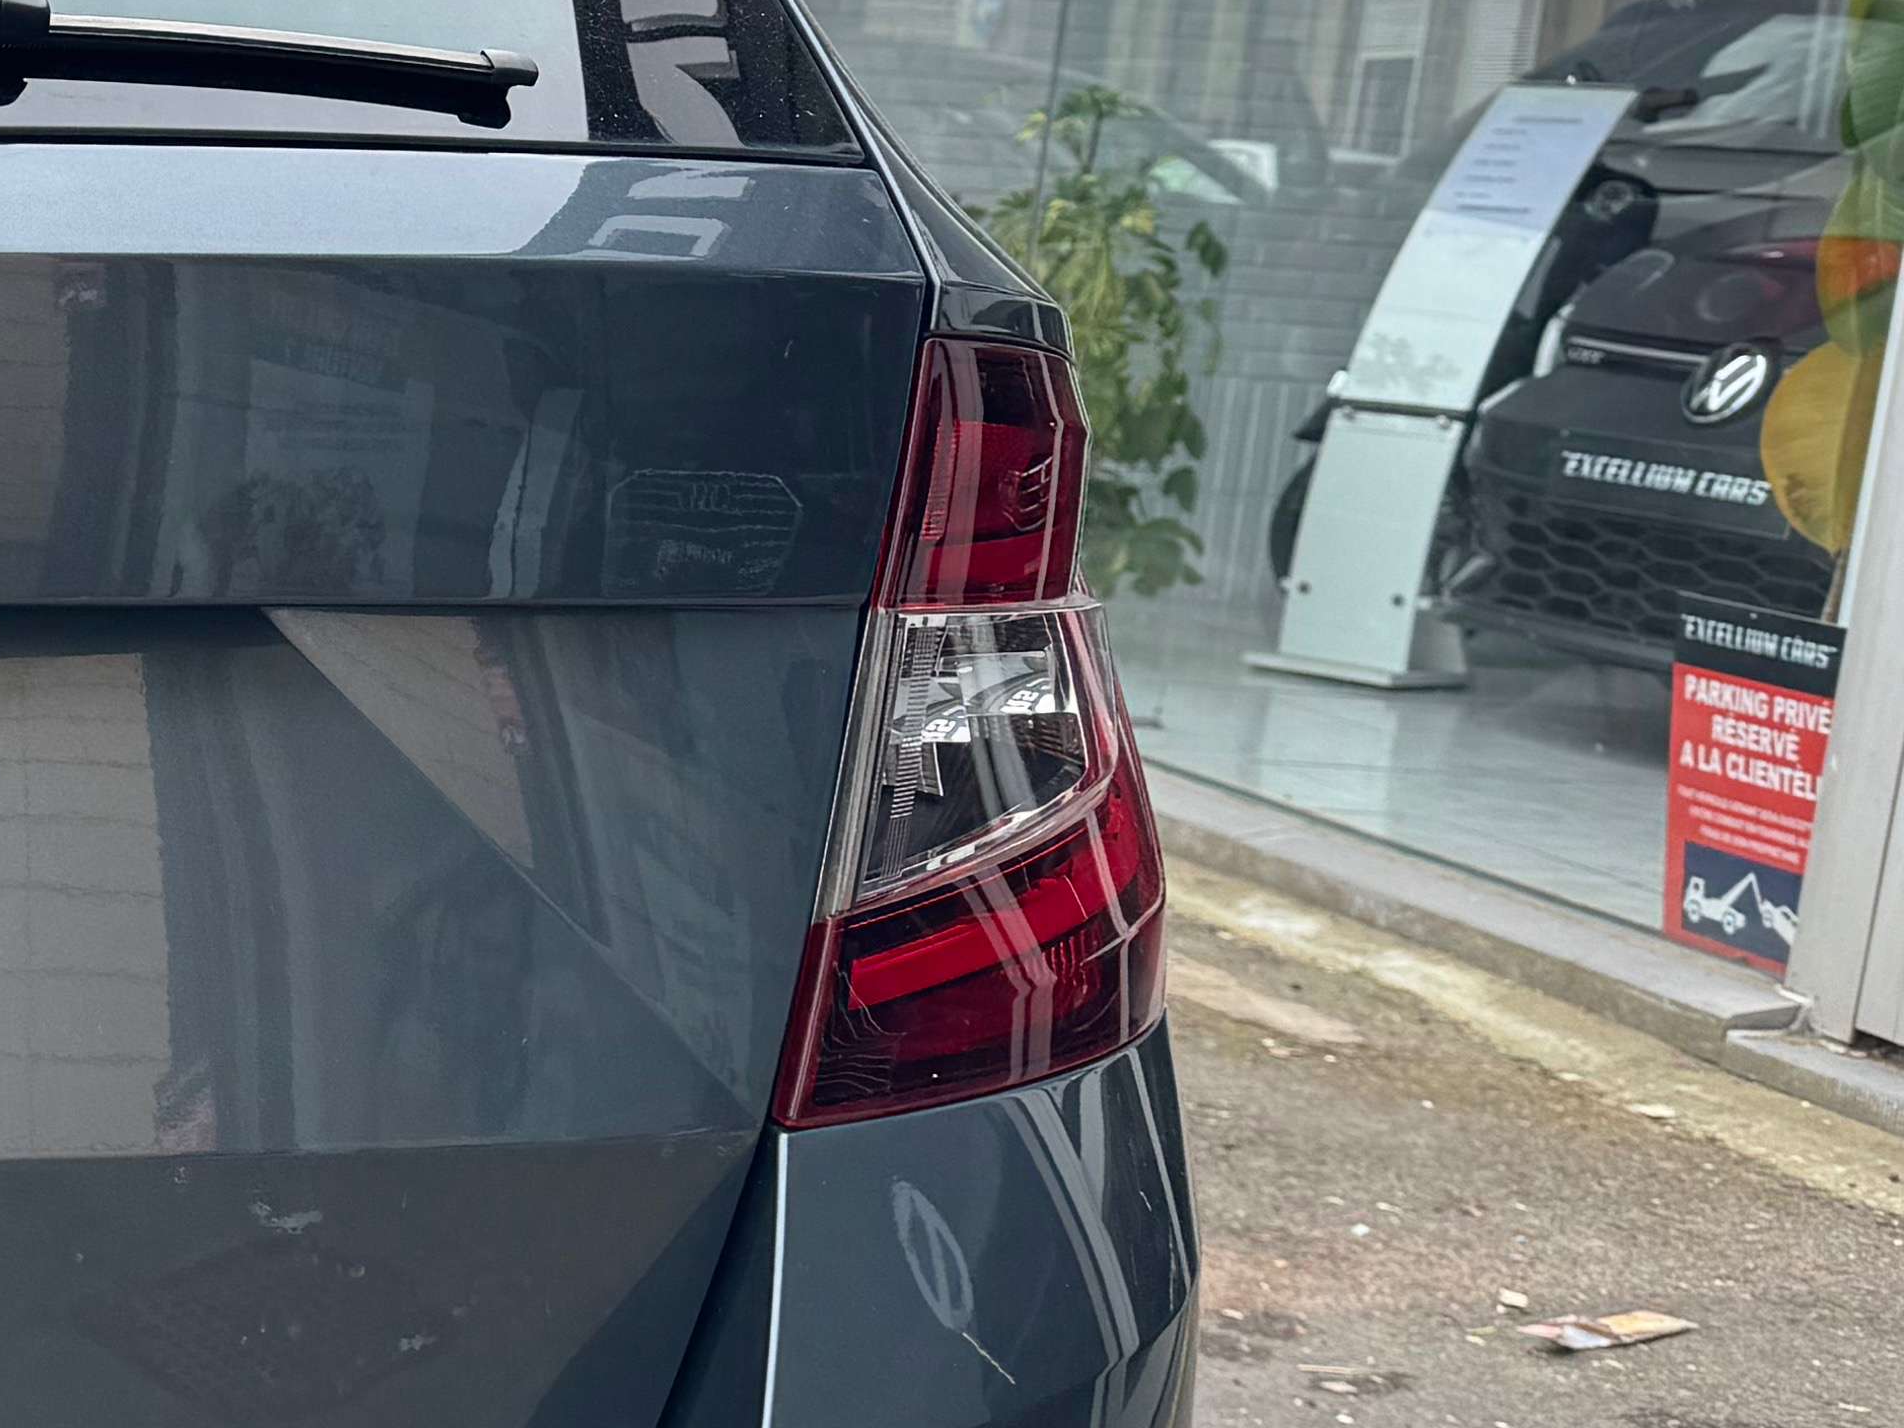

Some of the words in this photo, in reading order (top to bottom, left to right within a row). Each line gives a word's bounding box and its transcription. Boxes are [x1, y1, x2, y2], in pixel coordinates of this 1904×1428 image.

[1561, 450, 1696, 494] EXCELLIUM
[1695, 471, 1772, 506] CARS
[1680, 613, 1779, 658] EXCELLIUM
[1780, 635, 1839, 669] CARS
[1684, 673, 1769, 720] PARKING
[1680, 740, 1694, 768] A
[1697, 744, 1722, 775] LA
[1725, 752, 1817, 801] CLIENTÈL
